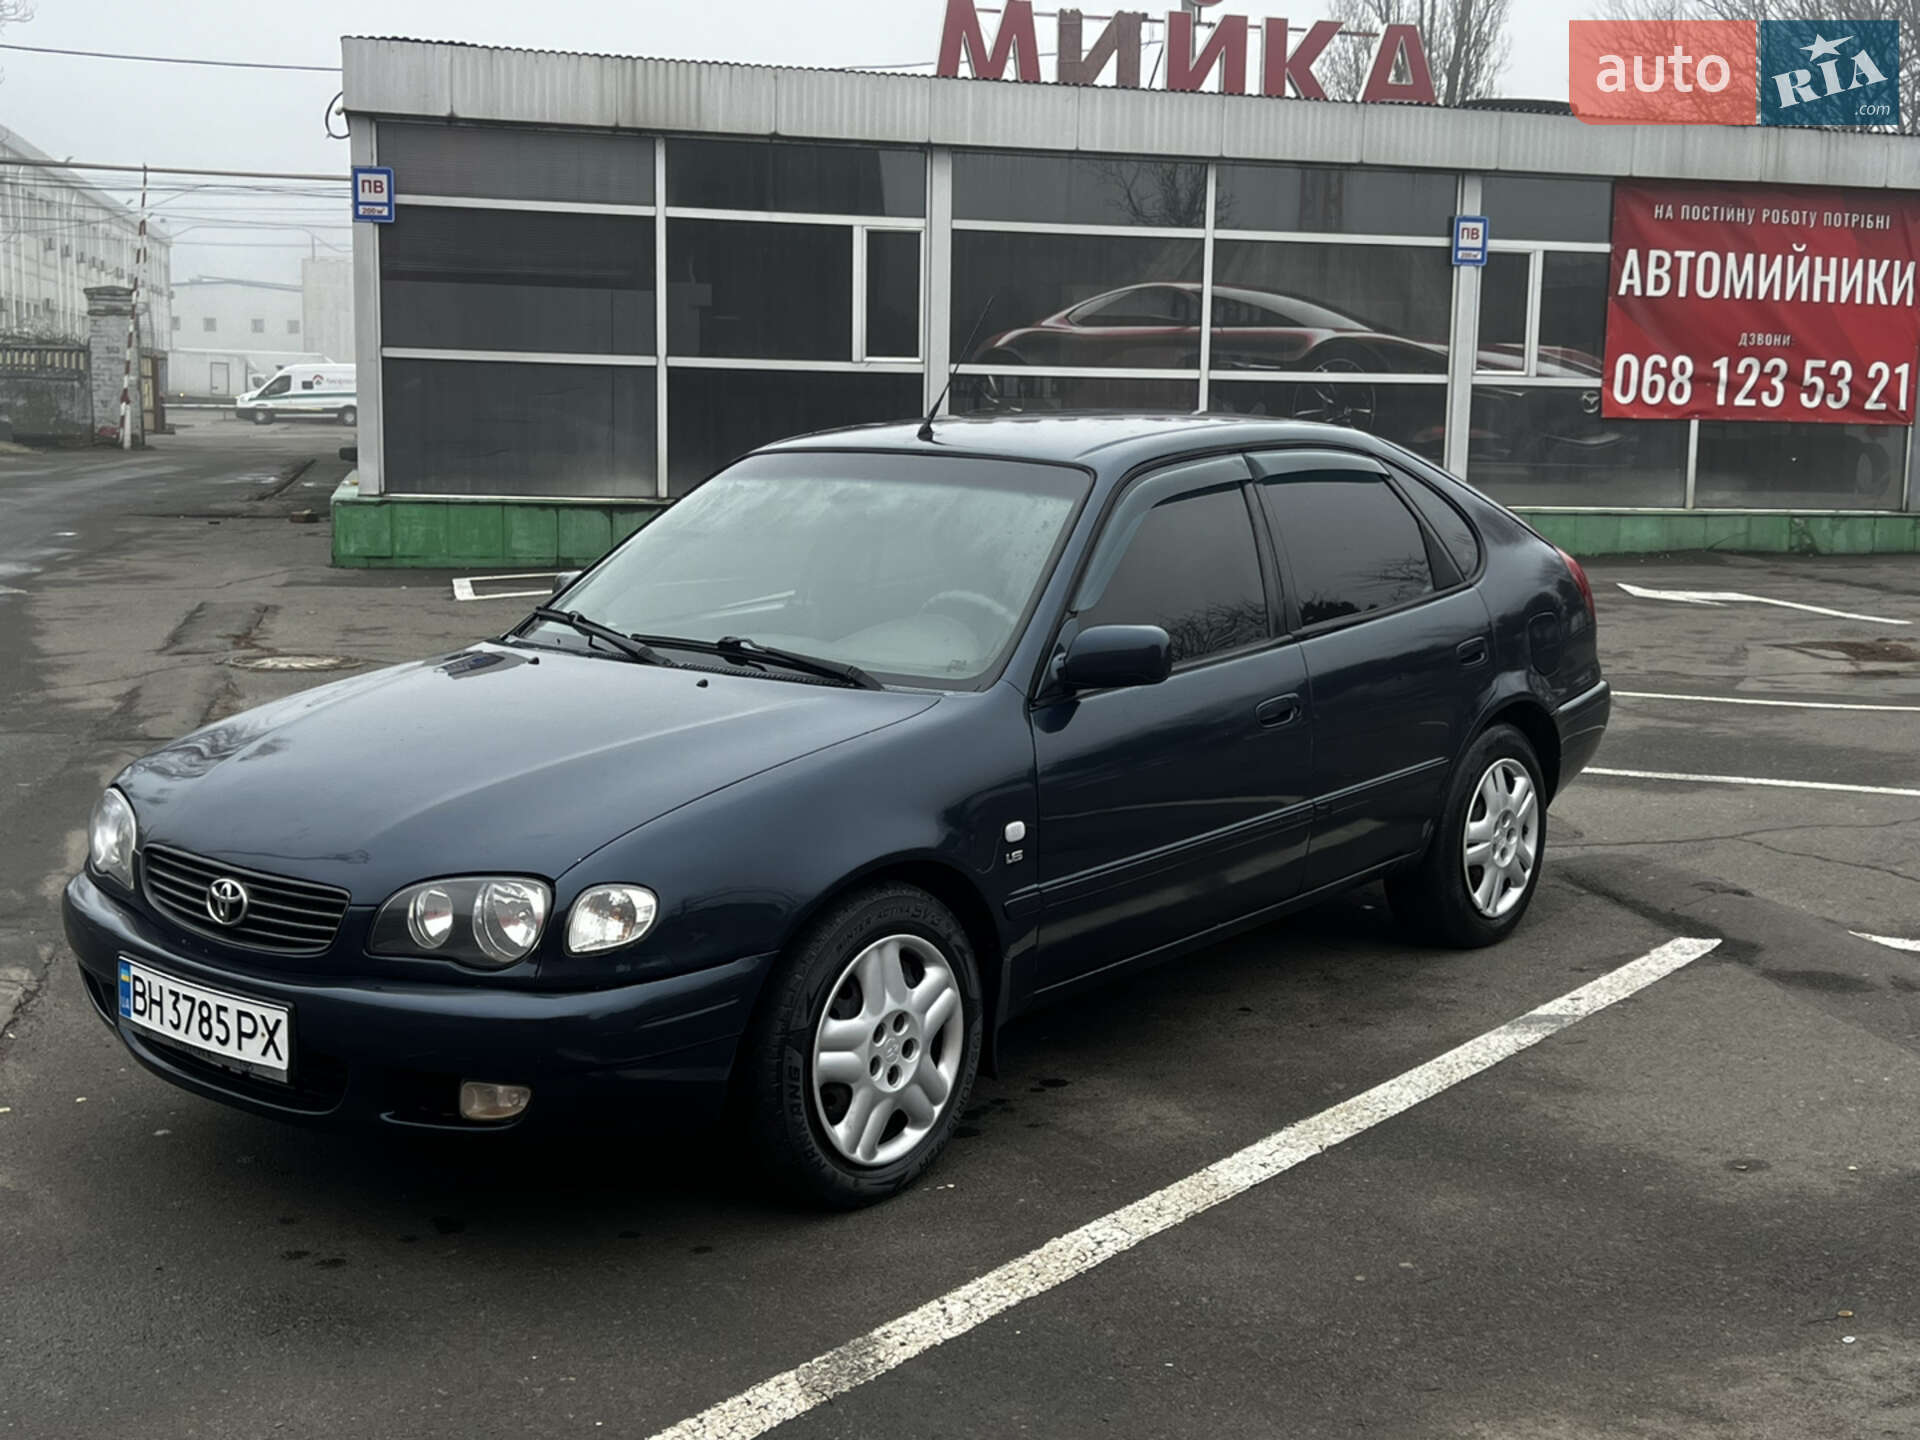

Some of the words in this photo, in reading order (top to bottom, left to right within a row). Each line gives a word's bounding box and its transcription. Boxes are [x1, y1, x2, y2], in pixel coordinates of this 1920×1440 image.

[361, 179, 384, 194] ПВ
[1654, 205, 1673, 220] НА
[1681, 204, 1755, 225] ПОСТІЙНУ
[1762, 208, 1817, 228] РОБОТУ
[1823, 212, 1891, 229] ПОТРІБНІ
[1461, 227, 1480, 240] ПВ
[1617, 243, 1916, 306] АВТОМИЙНИКИ
[1738, 333, 1791, 347] ДЗВОНИ
[1613, 353, 1694, 406] 068
[1712, 357, 1788, 407] 123
[1800, 359, 1853, 409] 53
[1864, 361, 1910, 411] 21
